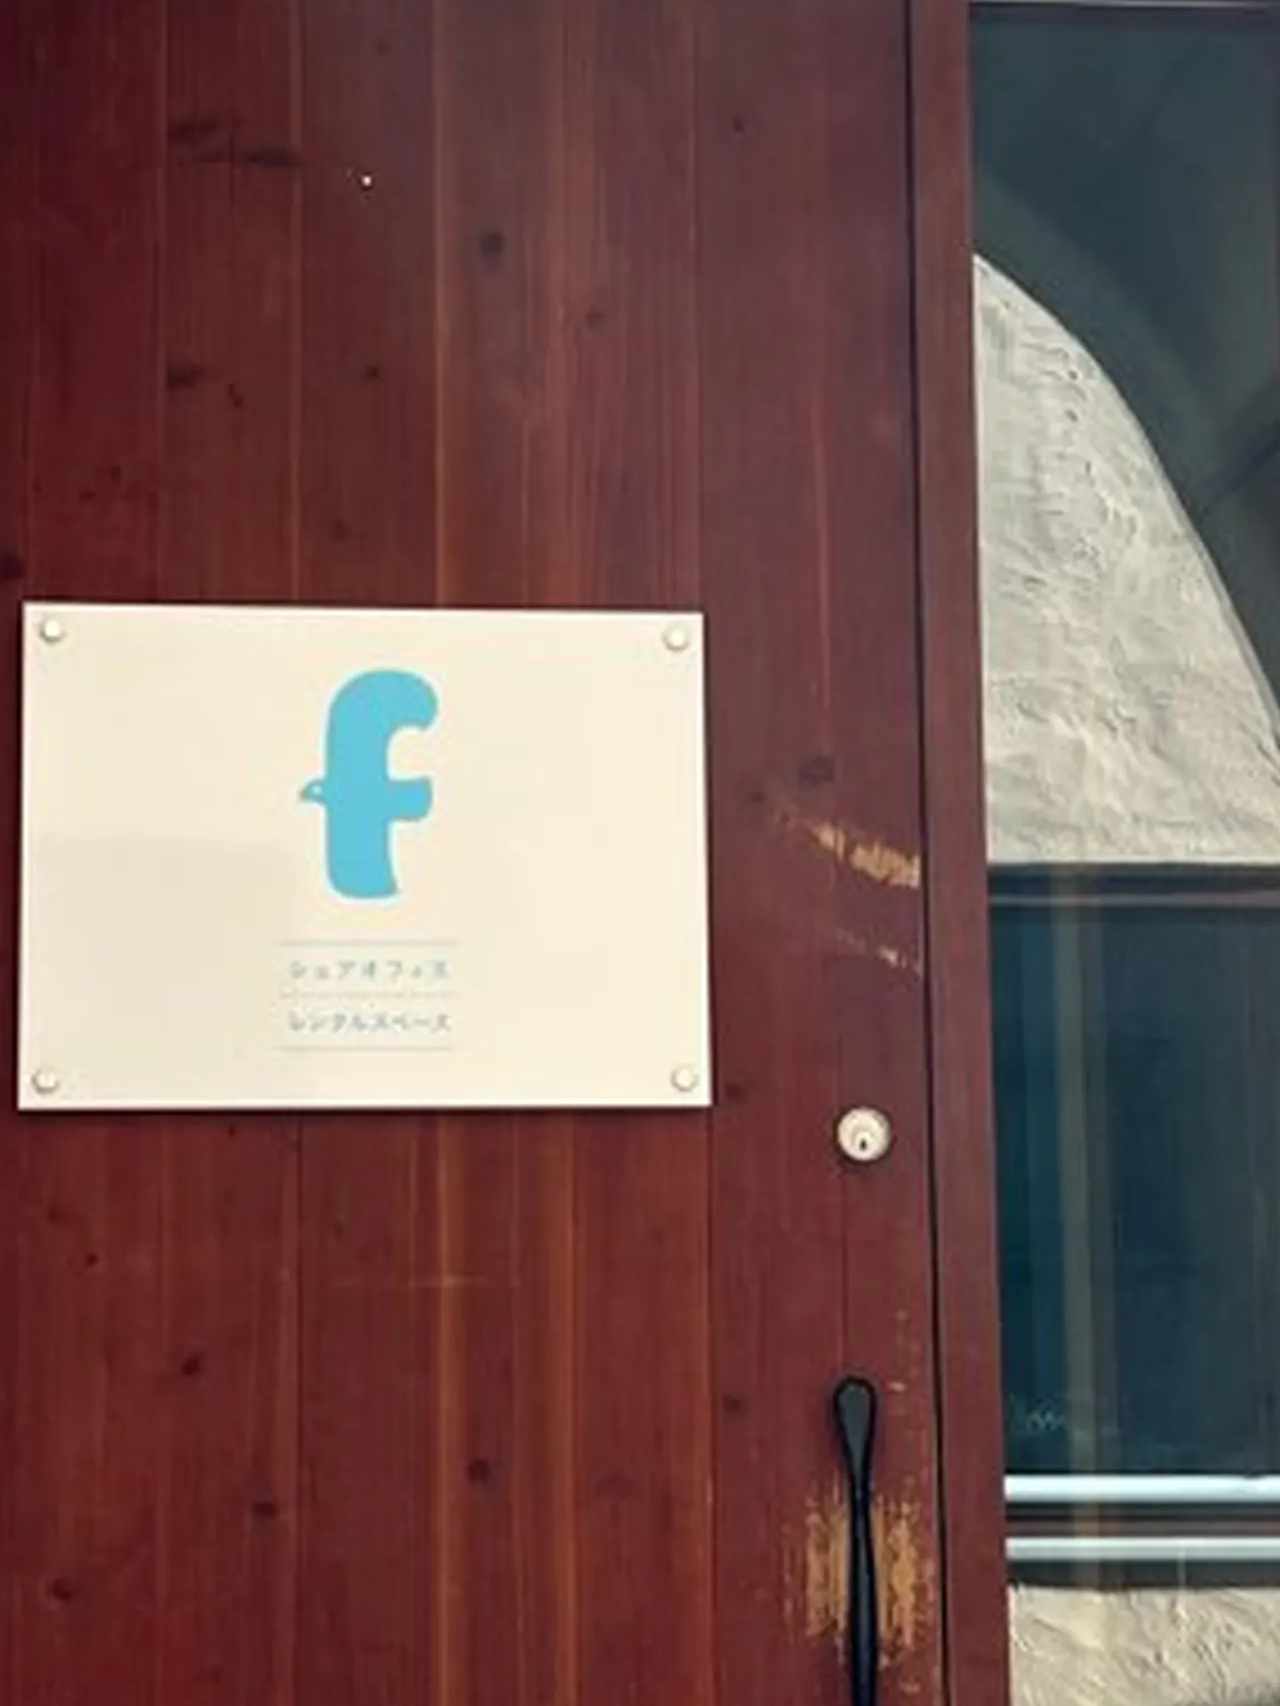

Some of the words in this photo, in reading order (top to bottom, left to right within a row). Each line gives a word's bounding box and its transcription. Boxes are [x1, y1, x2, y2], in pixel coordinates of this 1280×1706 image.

[289, 959, 450, 981] シェアオフィス
[288, 1009, 452, 1033] レンタルスペース
